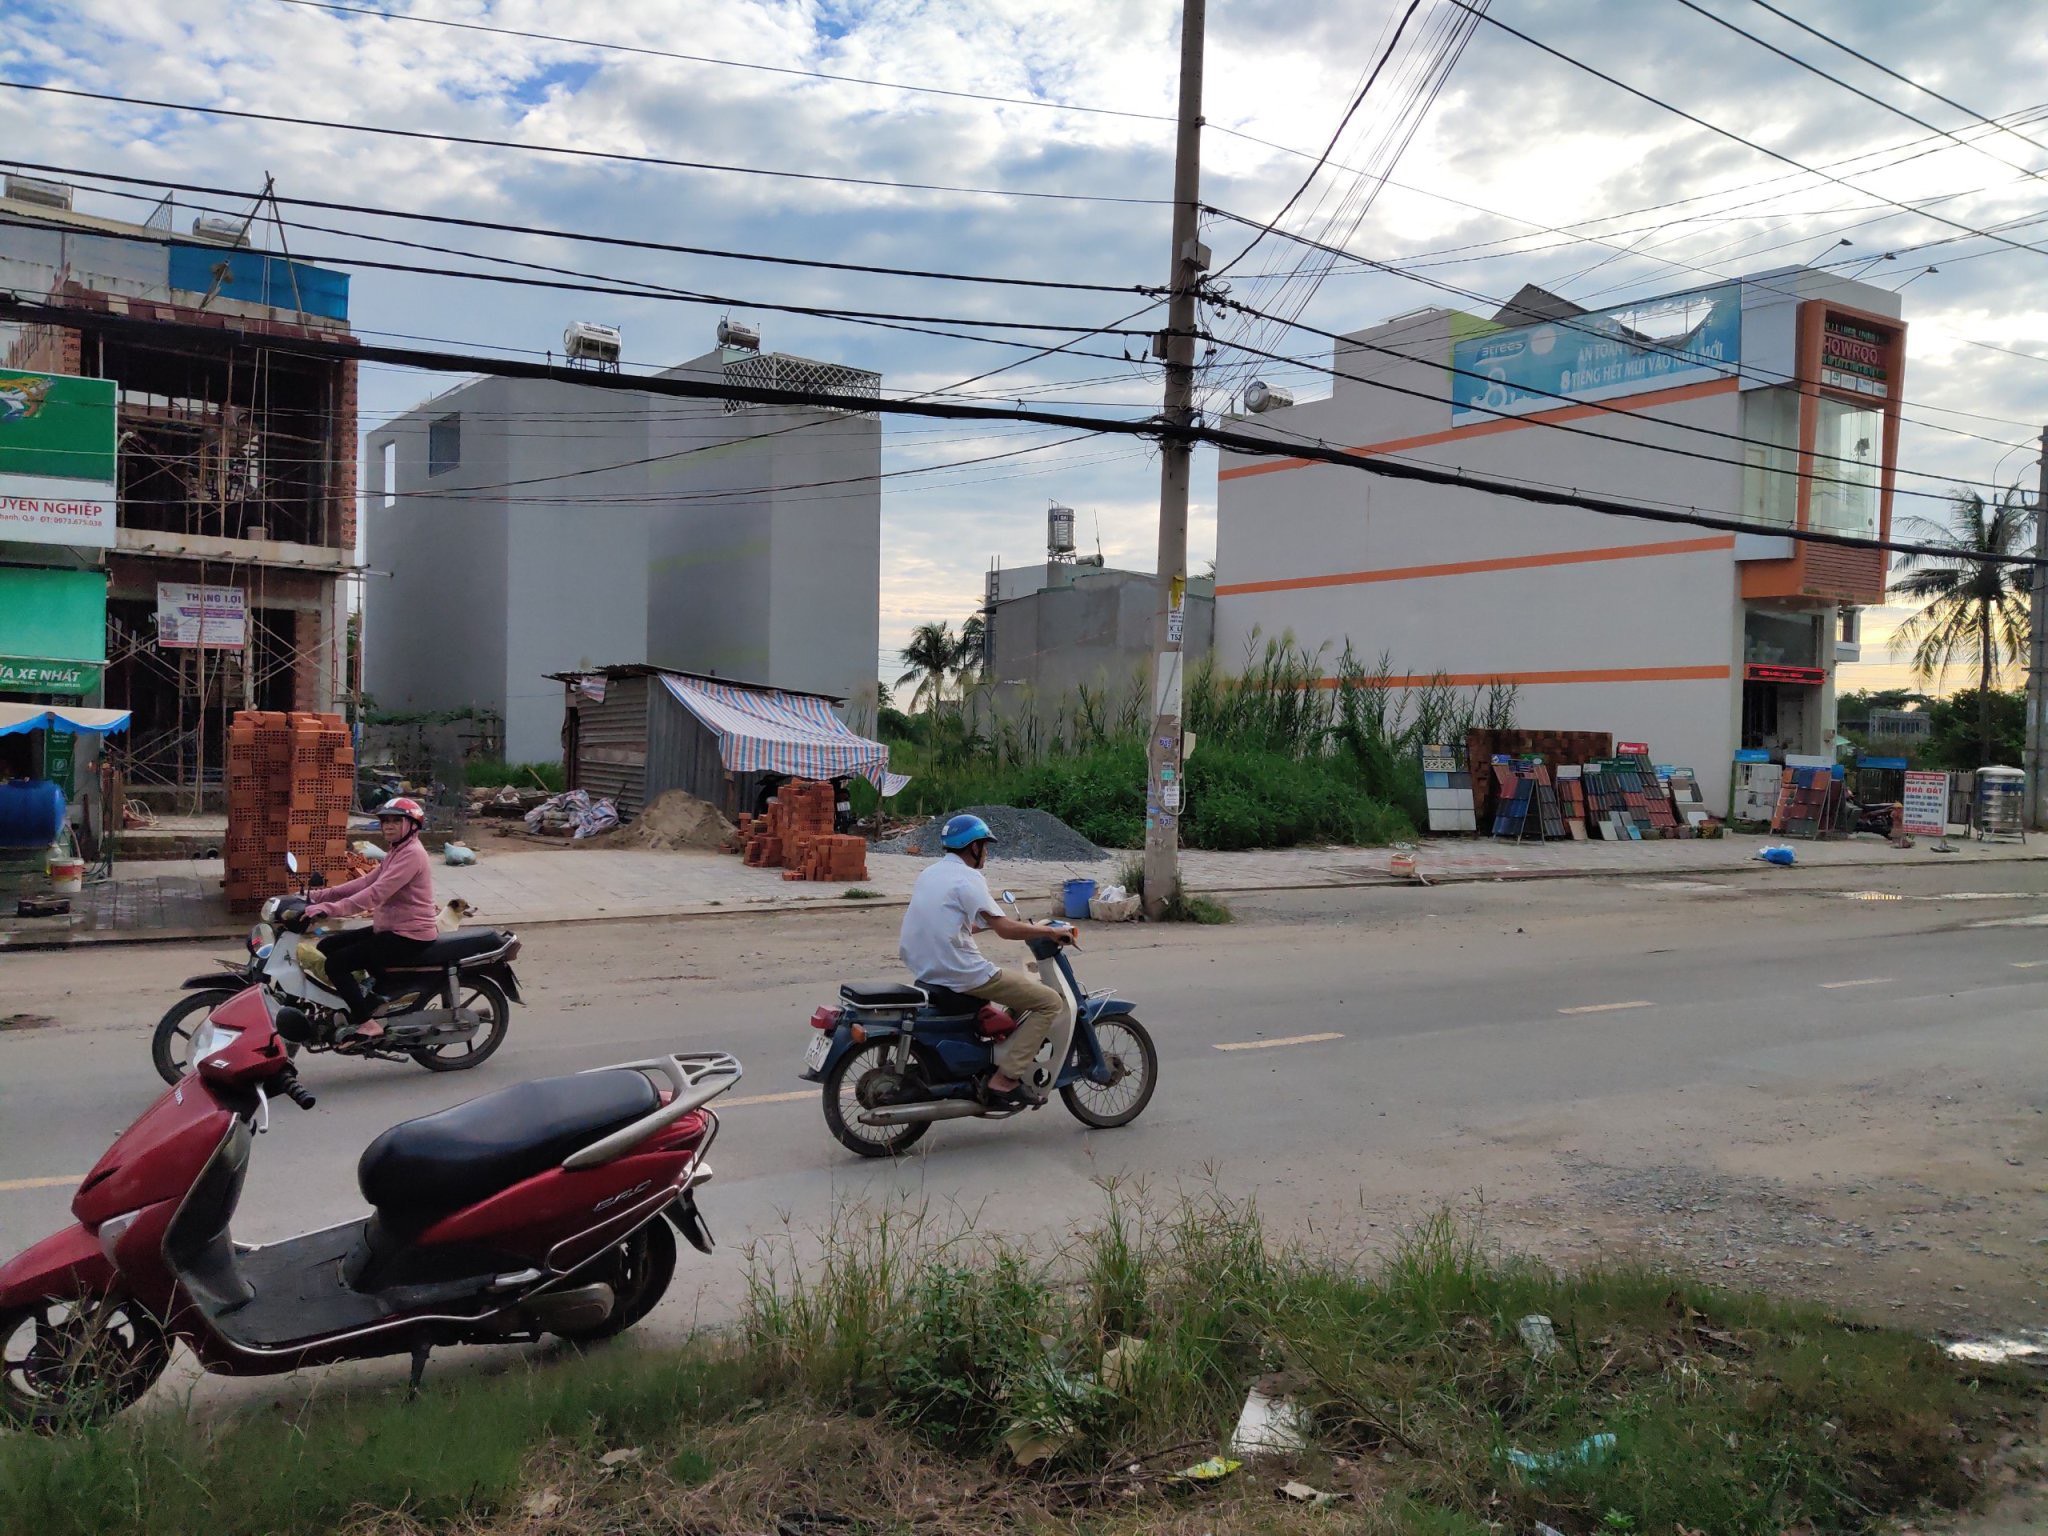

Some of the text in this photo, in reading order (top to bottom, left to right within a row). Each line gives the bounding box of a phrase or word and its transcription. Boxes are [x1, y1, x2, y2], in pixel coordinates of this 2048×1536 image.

[44, 501, 102, 518] NGHIỆP
[17, 668, 38, 680] XE
[40, 666, 81, 682] NHẤT
